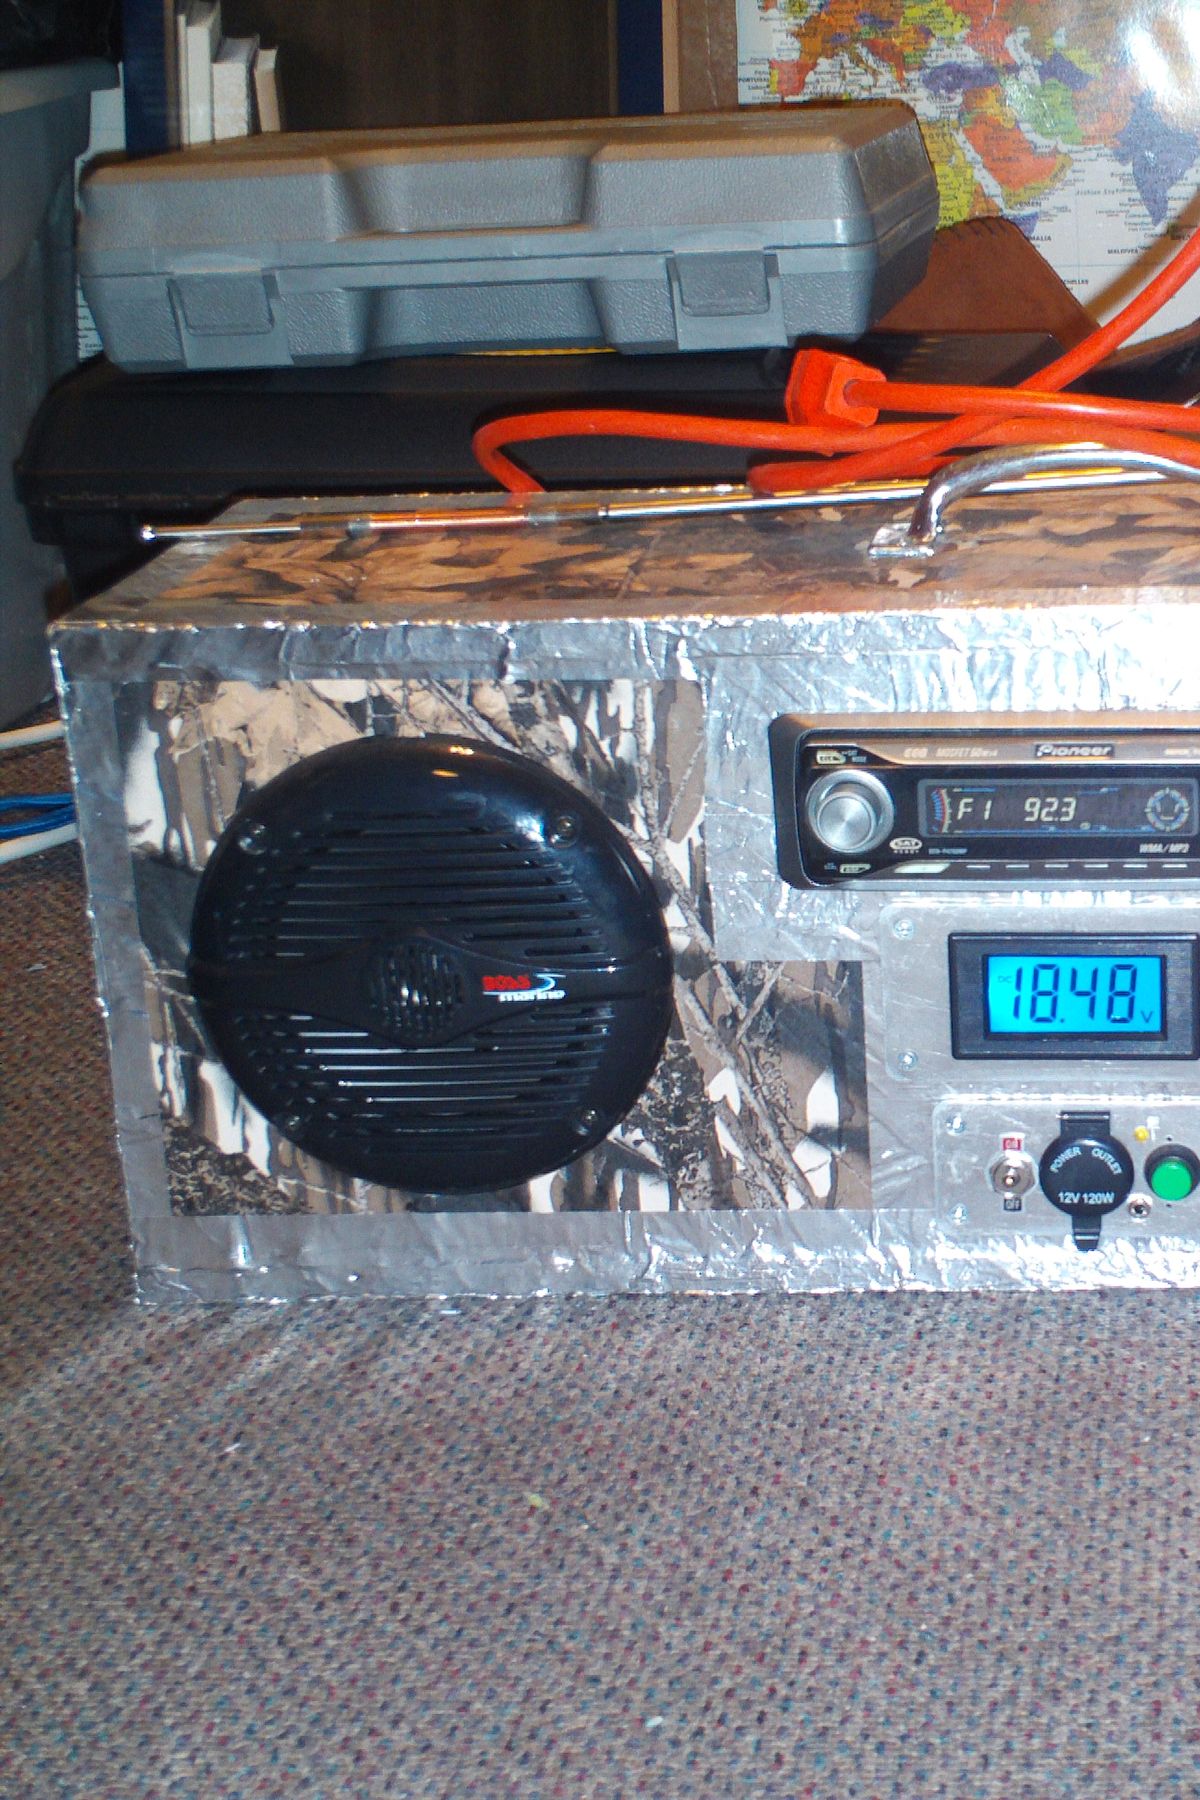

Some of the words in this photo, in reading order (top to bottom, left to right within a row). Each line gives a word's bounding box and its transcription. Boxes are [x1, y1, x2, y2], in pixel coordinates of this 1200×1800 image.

[1036, 744, 1112, 757] Pioneer
[1013, 963, 1138, 1024] 18.48
[1050, 1146, 1082, 1173] POWER
[1091, 1148, 1123, 1175] OUTLET
[1058, 1192, 1081, 1203] 12V
[1082, 1192, 1115, 1205] 120W
